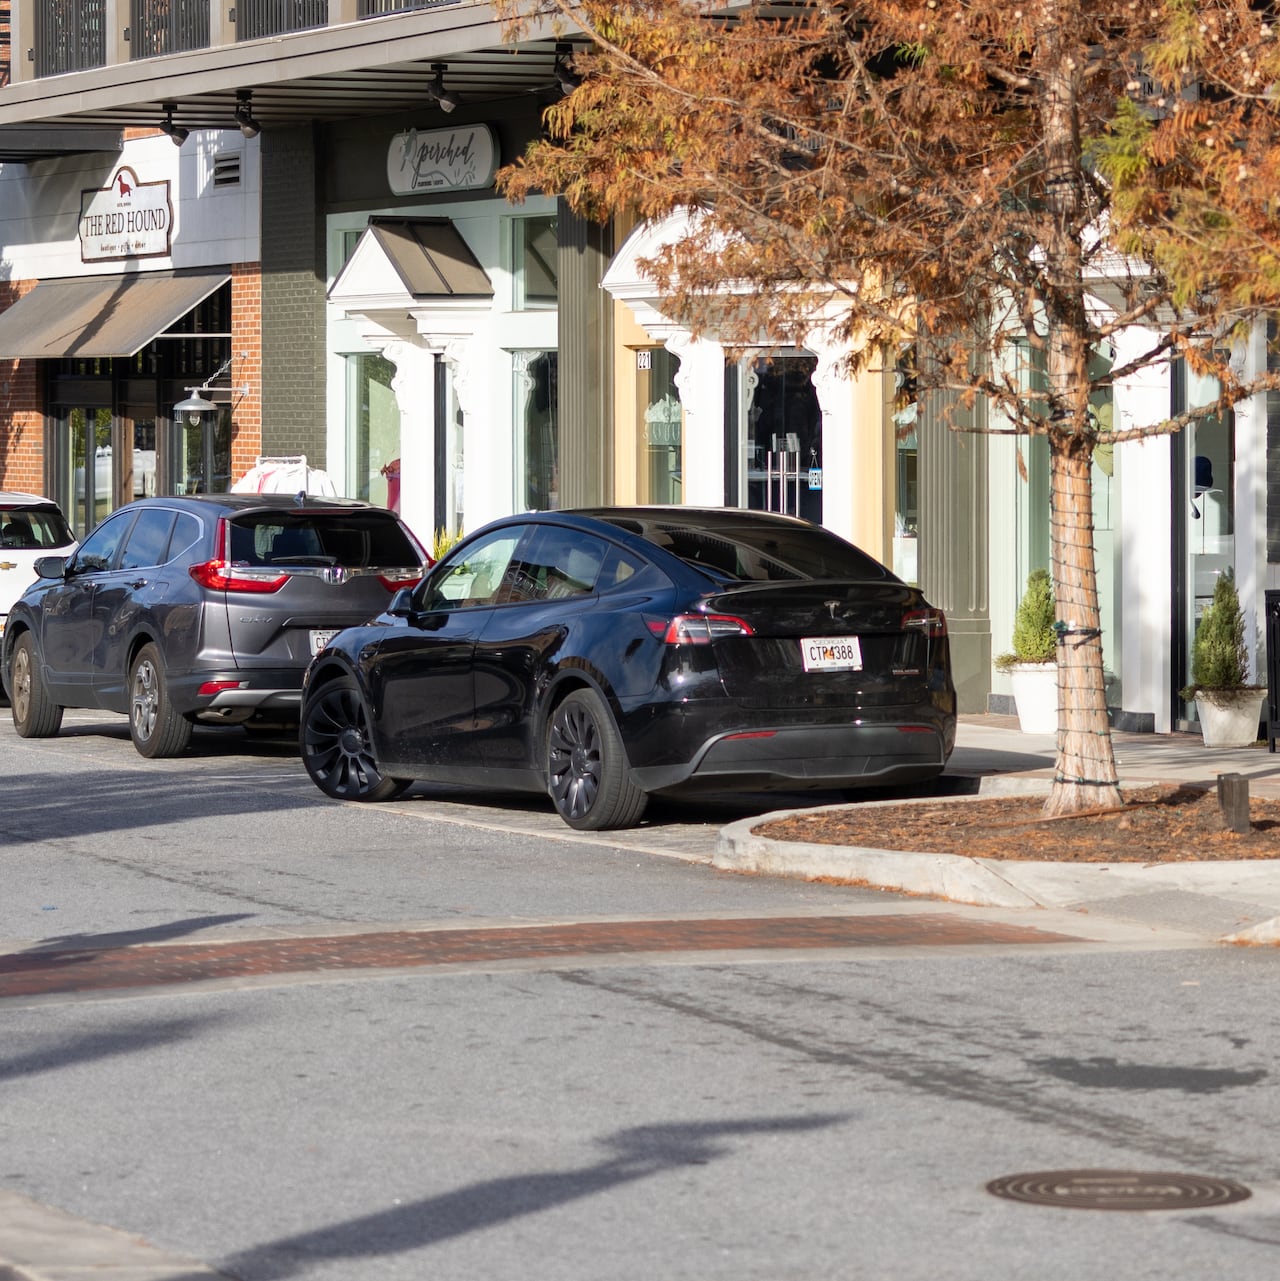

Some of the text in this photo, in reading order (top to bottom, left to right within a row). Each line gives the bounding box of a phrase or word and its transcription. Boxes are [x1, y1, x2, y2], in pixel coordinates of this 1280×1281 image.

[411, 132, 475, 189] perched
[83, 208, 166, 237] THE RED HOUND
[638, 352, 650, 369] 221
[809, 645, 854, 661] CTP4388
